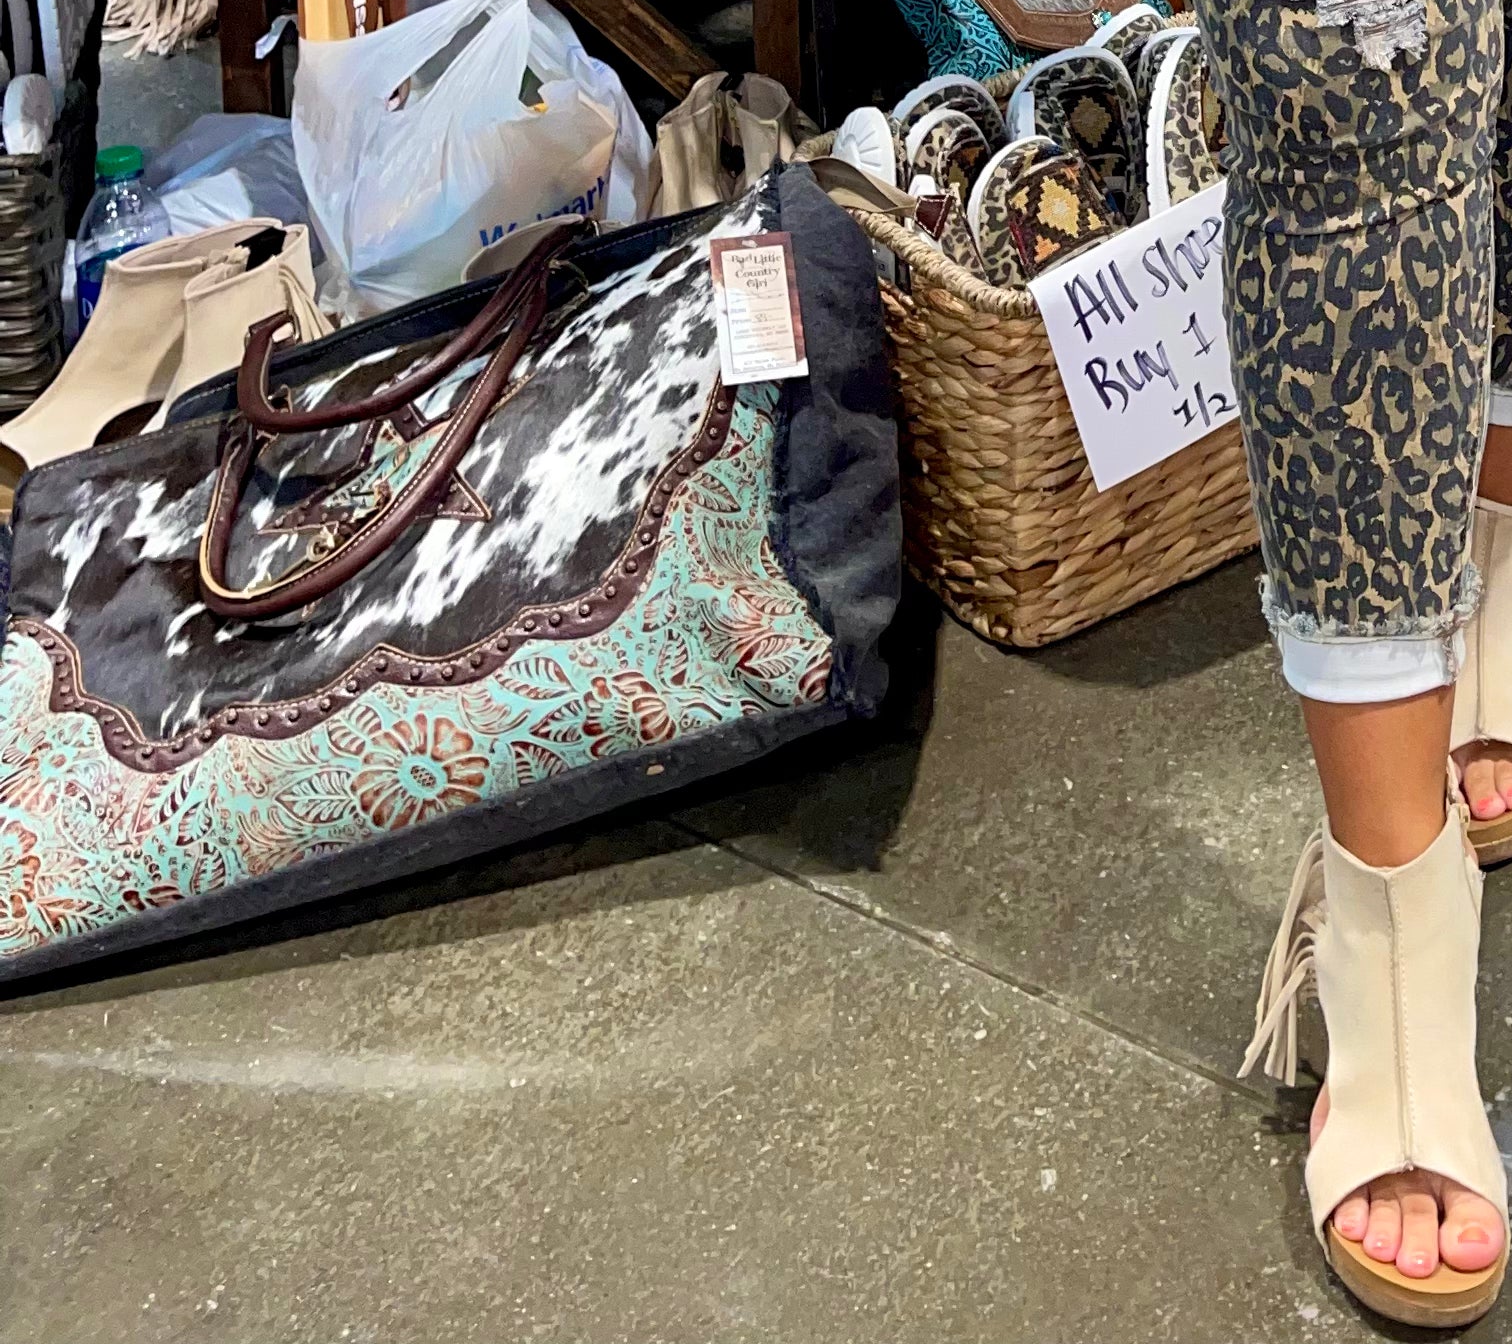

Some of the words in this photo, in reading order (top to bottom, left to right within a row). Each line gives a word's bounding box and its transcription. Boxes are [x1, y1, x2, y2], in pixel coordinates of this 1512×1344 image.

[735, 266, 781, 281] Country
[1063, 259, 1139, 344] All
[1084, 340, 1179, 414] Buy
[1182, 312, 1217, 357] 1
[1172, 381, 1237, 428] 1/2
